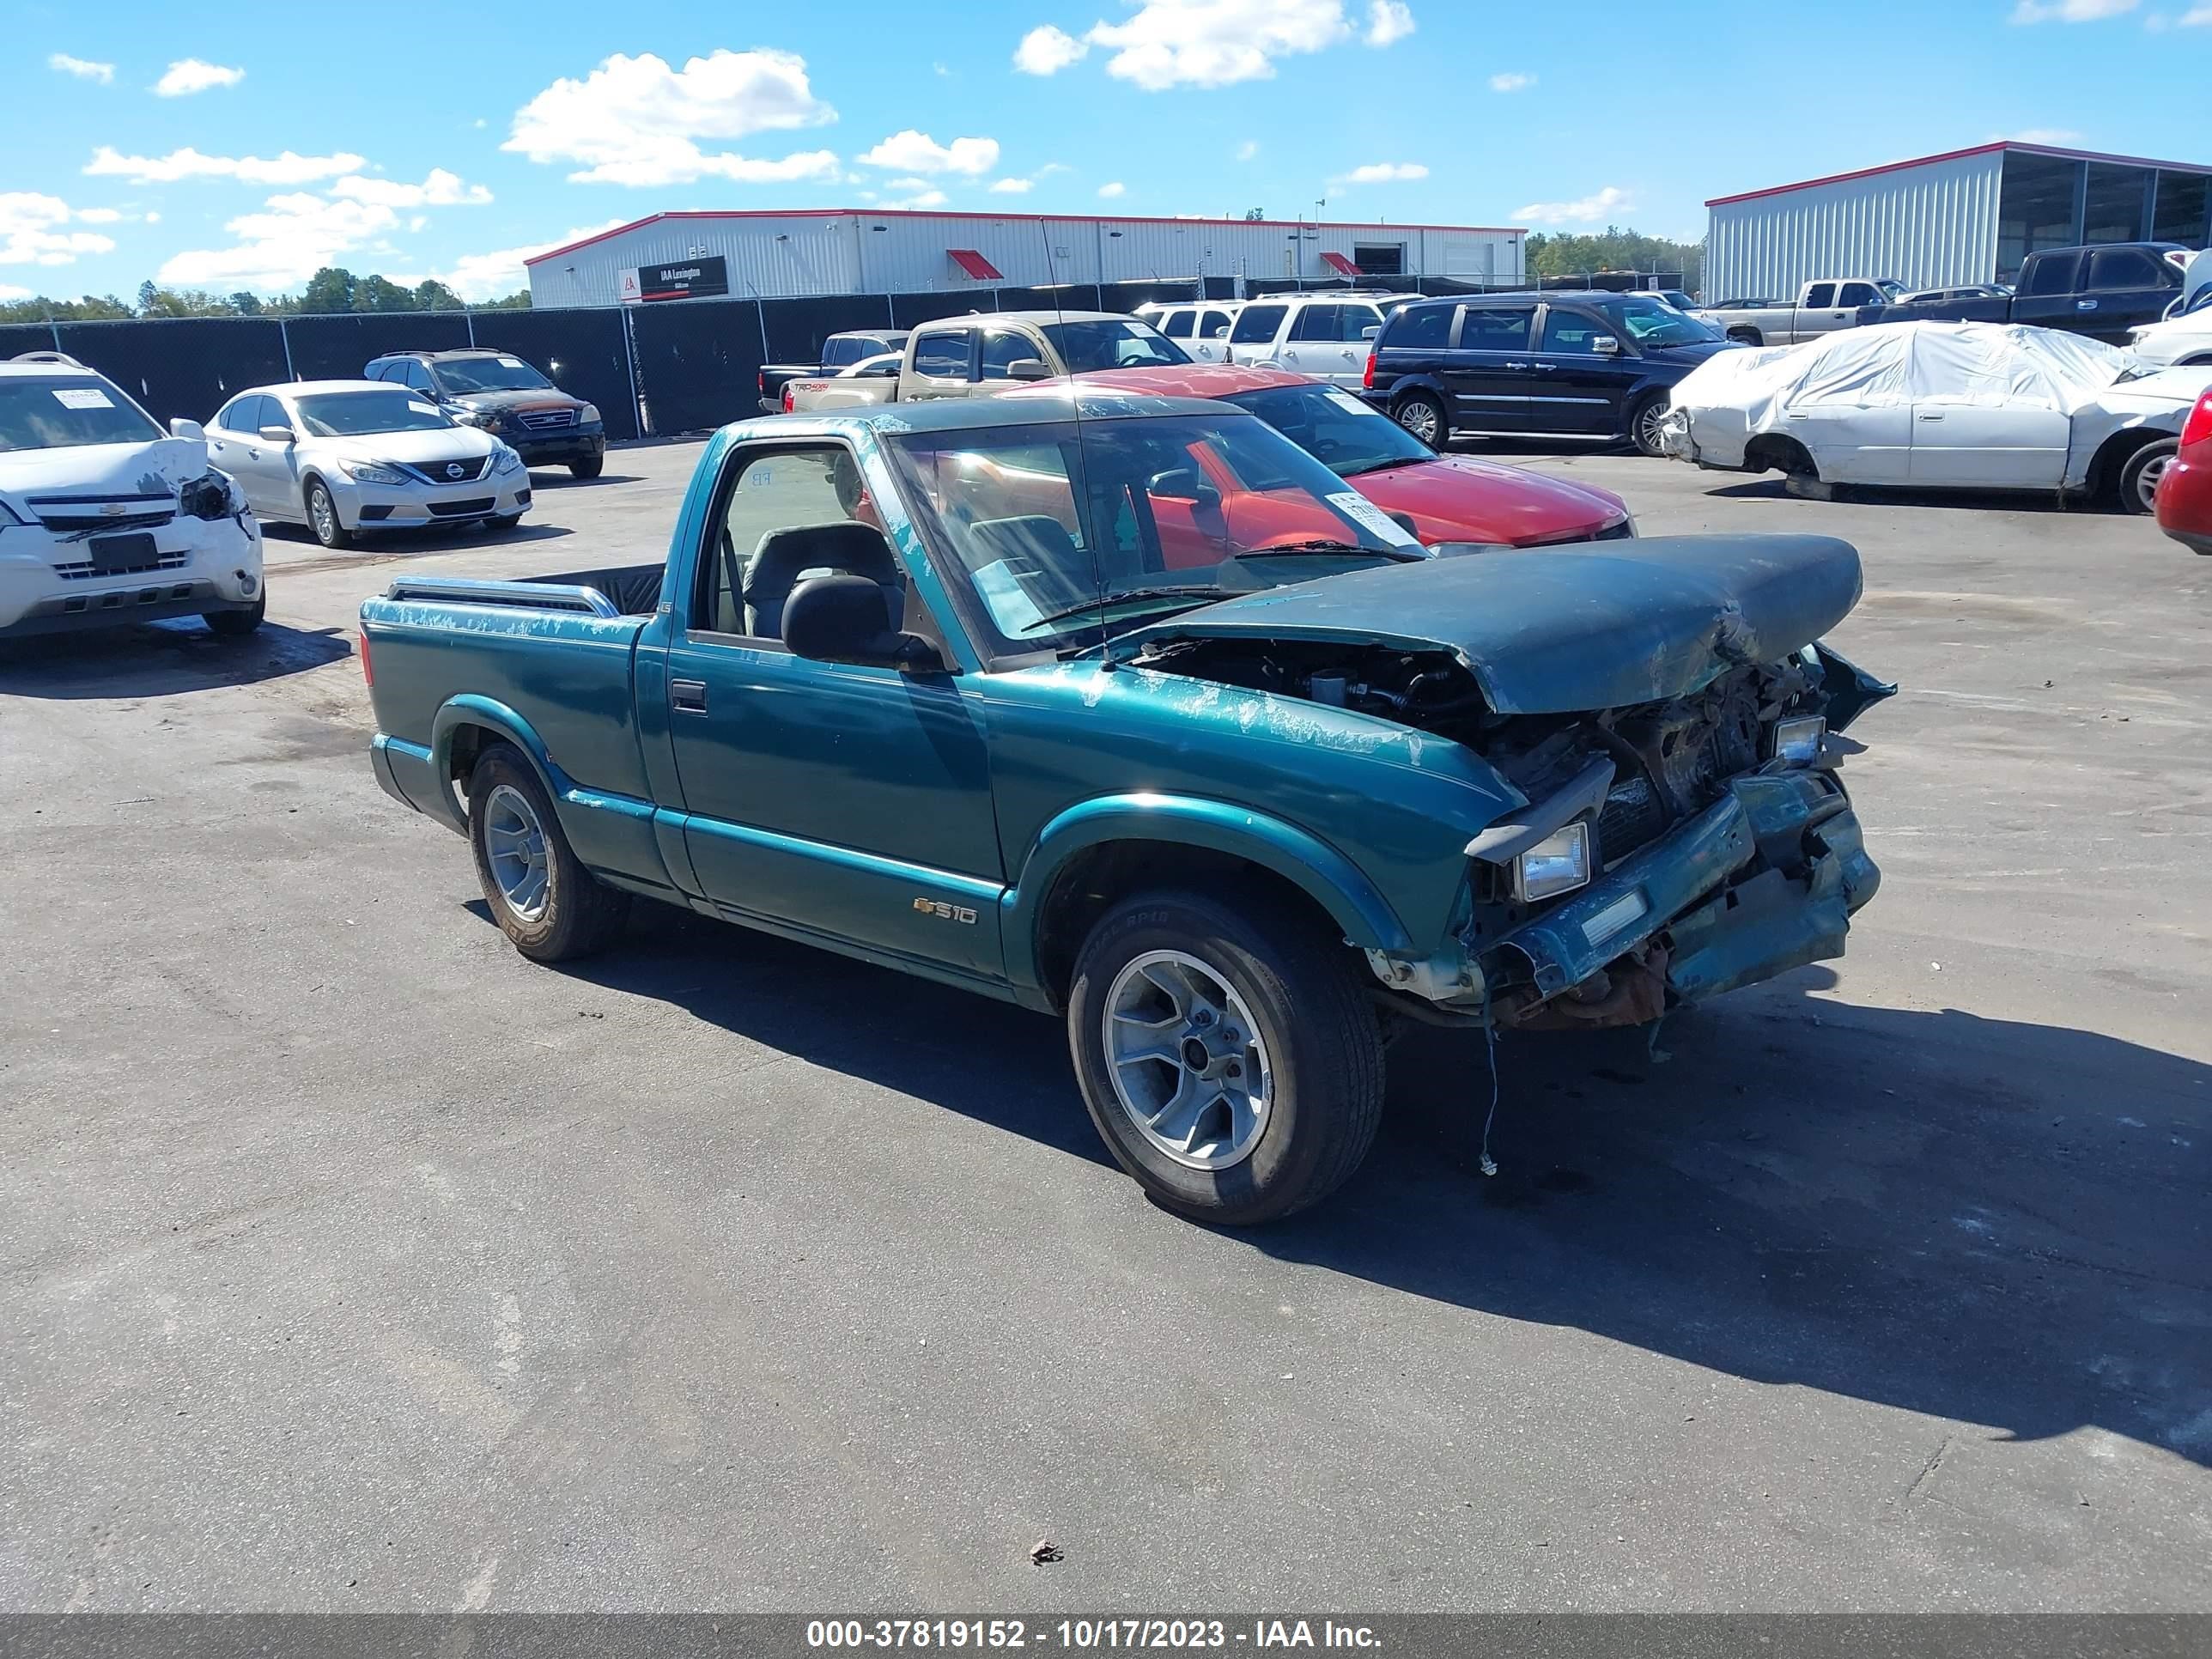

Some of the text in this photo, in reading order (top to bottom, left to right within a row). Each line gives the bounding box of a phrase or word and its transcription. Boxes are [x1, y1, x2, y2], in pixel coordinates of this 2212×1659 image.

[660, 267, 701, 281] IAA Lexington
[794, 383, 811, 392] TRD
[935, 902, 977, 925] S10
